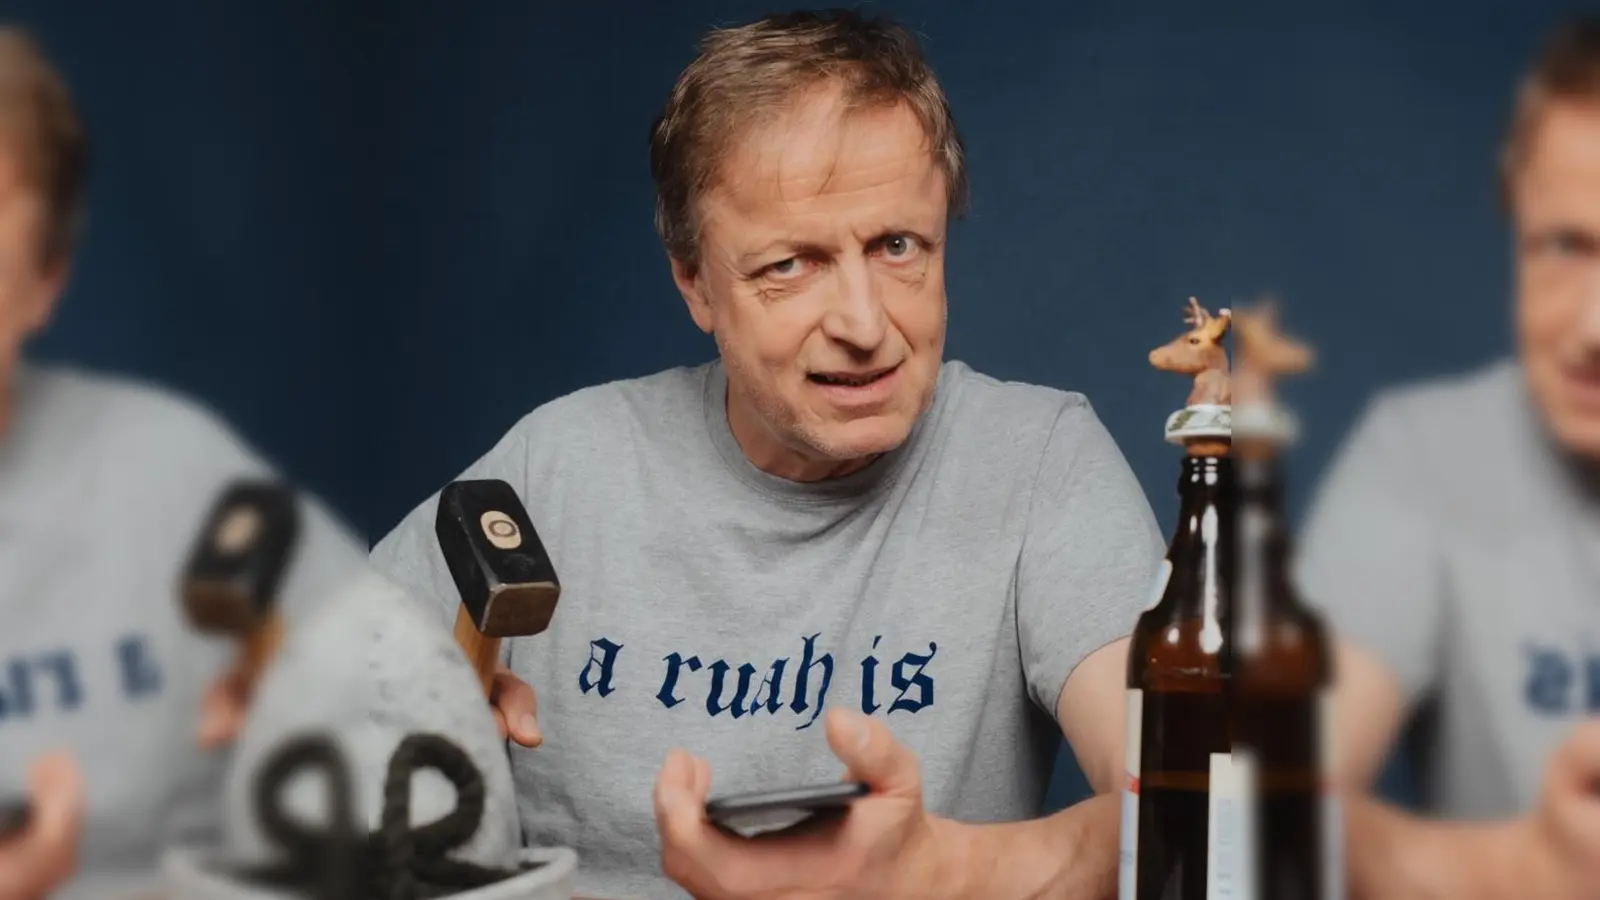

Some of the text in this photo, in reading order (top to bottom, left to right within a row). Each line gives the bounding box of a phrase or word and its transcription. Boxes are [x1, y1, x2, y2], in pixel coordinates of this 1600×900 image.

[579, 632, 937, 730] a ruah is
